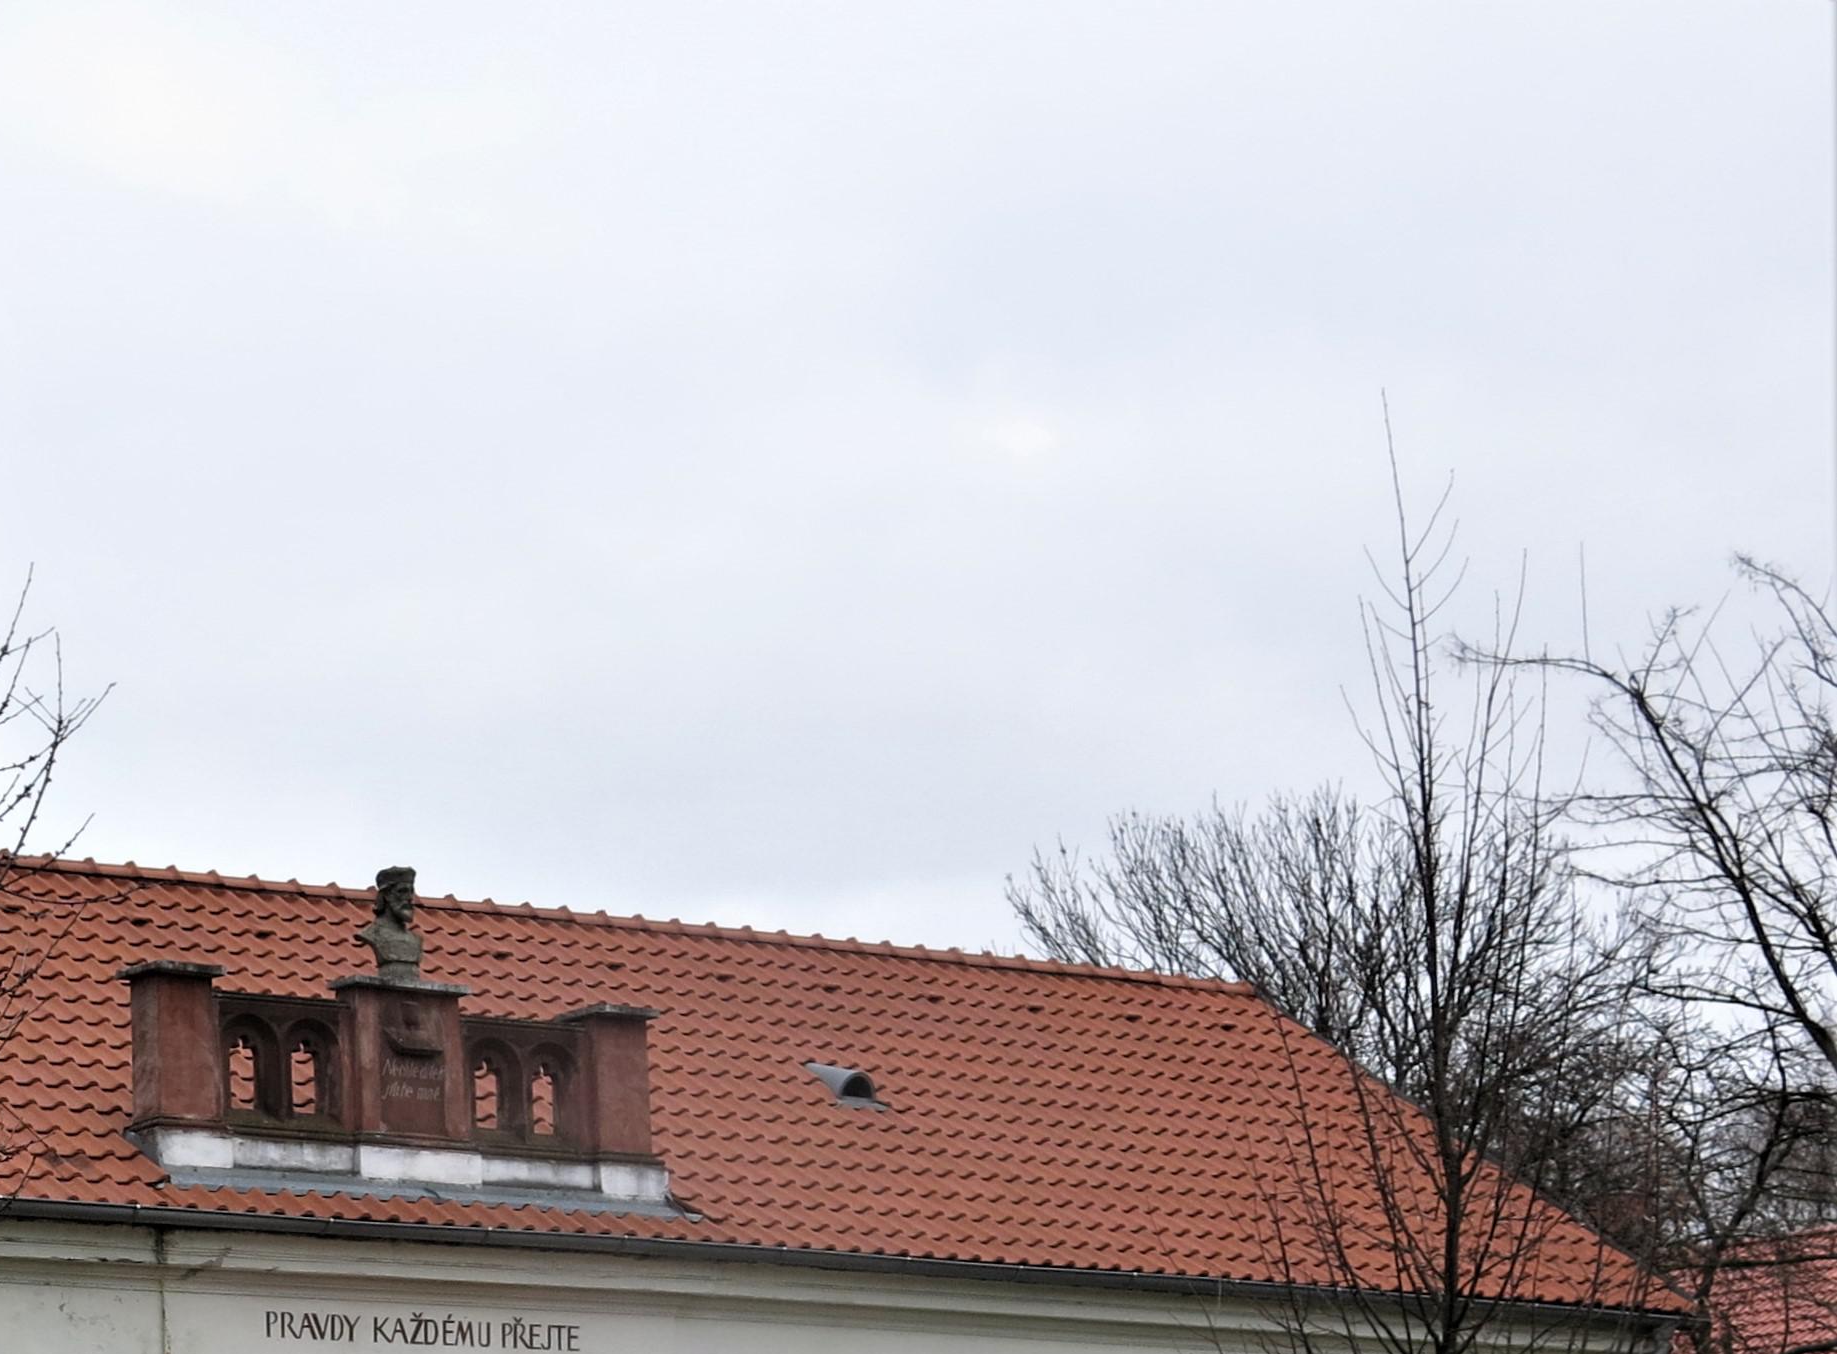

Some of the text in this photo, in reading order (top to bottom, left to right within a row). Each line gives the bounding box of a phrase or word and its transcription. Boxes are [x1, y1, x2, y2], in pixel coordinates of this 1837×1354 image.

[265, 1311, 581, 1352] PRAVDY KAŽDÉMU PŘEJTE
